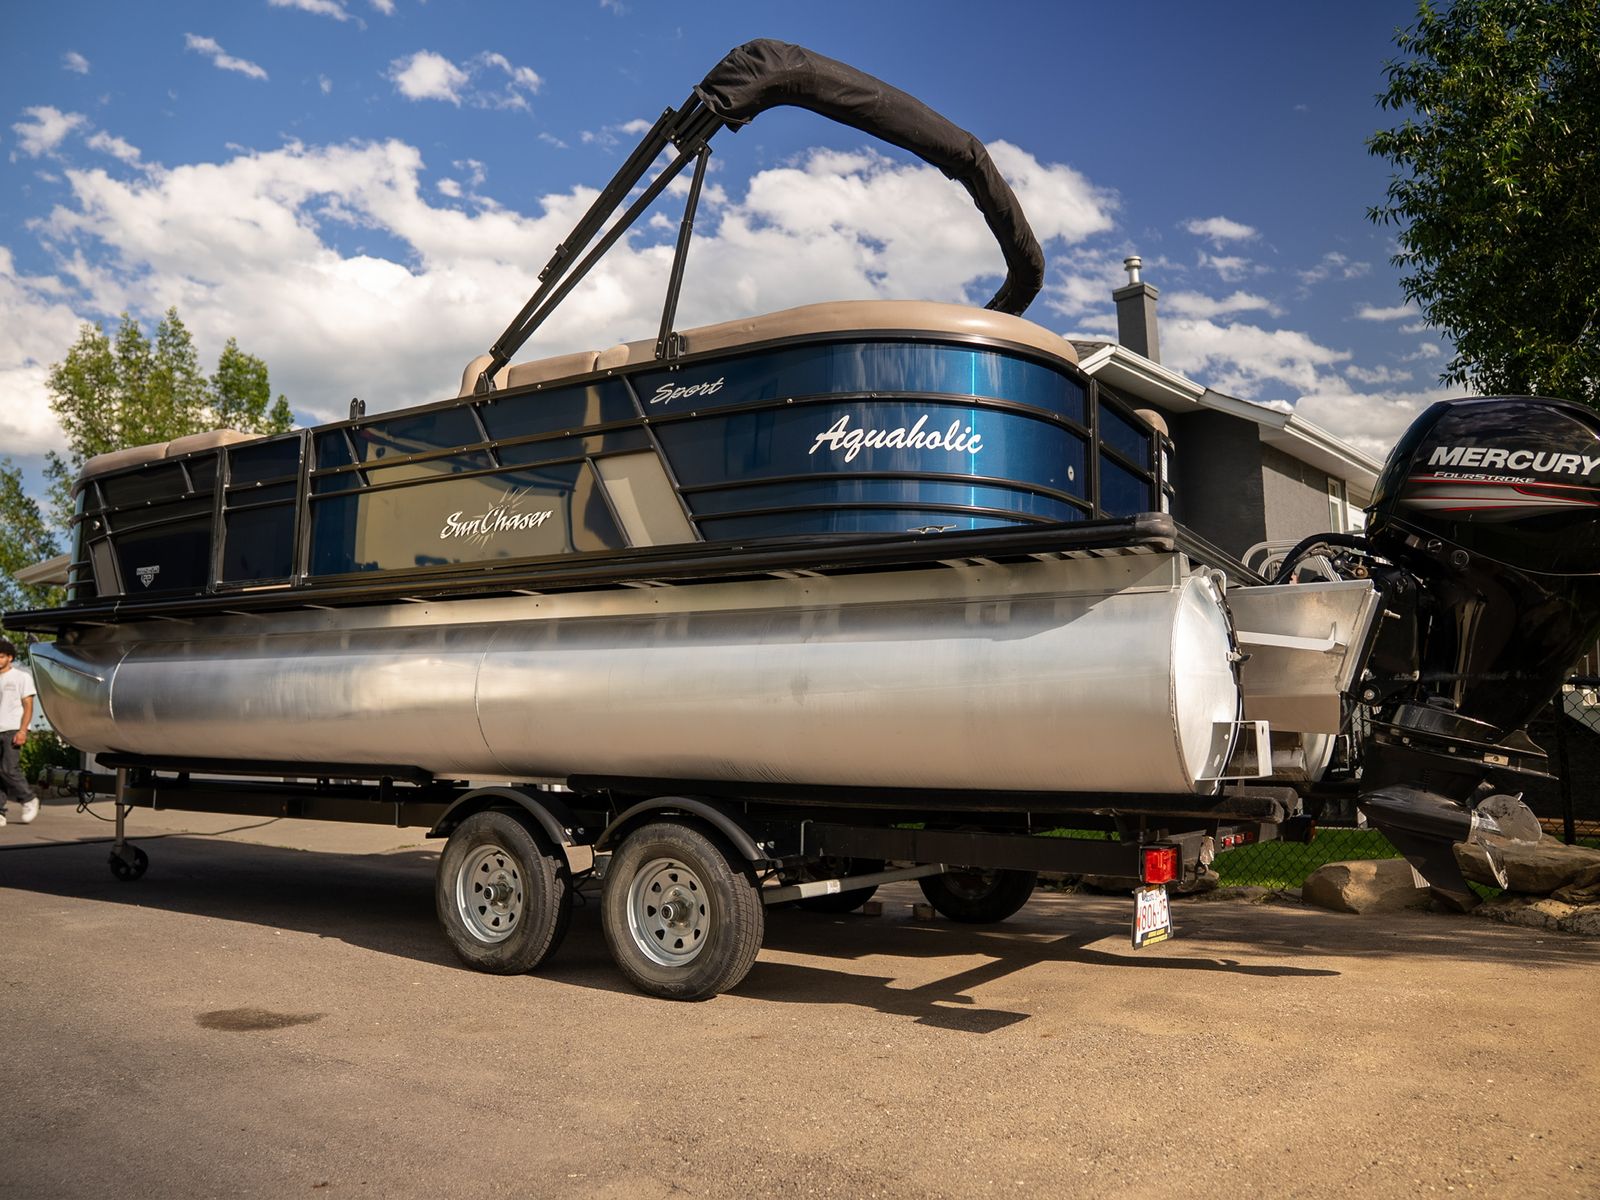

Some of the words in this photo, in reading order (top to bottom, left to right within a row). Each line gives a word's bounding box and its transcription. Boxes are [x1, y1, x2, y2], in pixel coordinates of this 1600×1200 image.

[650, 377, 724, 404] Sport
[808, 414, 984, 463] Aquaholic
[1427, 446, 1600, 476] MERCURY
